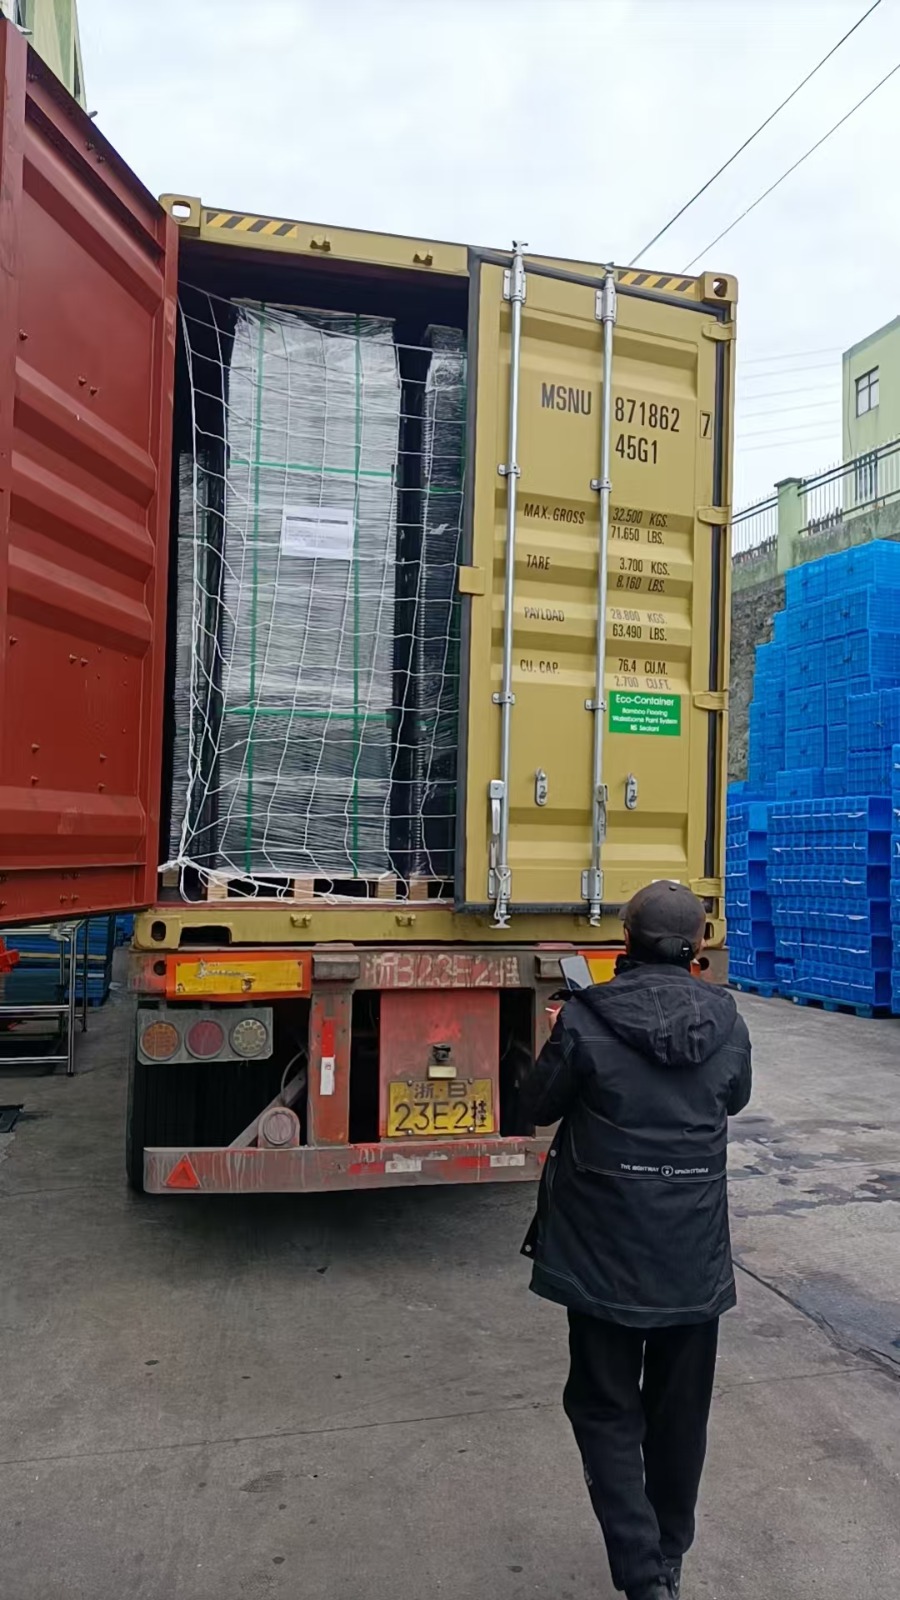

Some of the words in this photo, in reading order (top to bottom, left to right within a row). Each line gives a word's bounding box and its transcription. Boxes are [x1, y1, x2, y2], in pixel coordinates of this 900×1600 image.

[541, 382, 592, 415] MSNU
[615, 397, 680, 433] 871862
[701, 412, 711, 437] 7
[615, 433, 657, 464] 45G1
[524, 503, 550, 520] MAX.
[553, 507, 586, 524] GROSS
[613, 507, 643, 524] 32.500
[649, 512, 668, 528] KGS.
[611, 525, 640, 541] 71.650
[647, 529, 664, 545] LBS.
[526, 553, 551, 570] TARE
[620, 557, 643, 572] 3.700
[651, 561, 670, 576] KGS.
[616, 574, 642, 590] 8.160
[648, 578, 665, 593] LBS.
[524, 606, 565, 622] PAYLOAD
[647, 612, 668, 625] KGS.
[612, 623, 642, 639] 63.490
[649, 626, 668, 642] LBS.
[520, 659, 537, 673] CU.
[540, 660, 560, 674] CAP.
[618, 658, 637, 673] 76.4
[644, 660, 668, 675] CU.M.
[614, 675, 639, 688] 2.700
[616, 694, 674, 706] Eco-Container
[395, 1100, 487, 1132] 23E2挂
